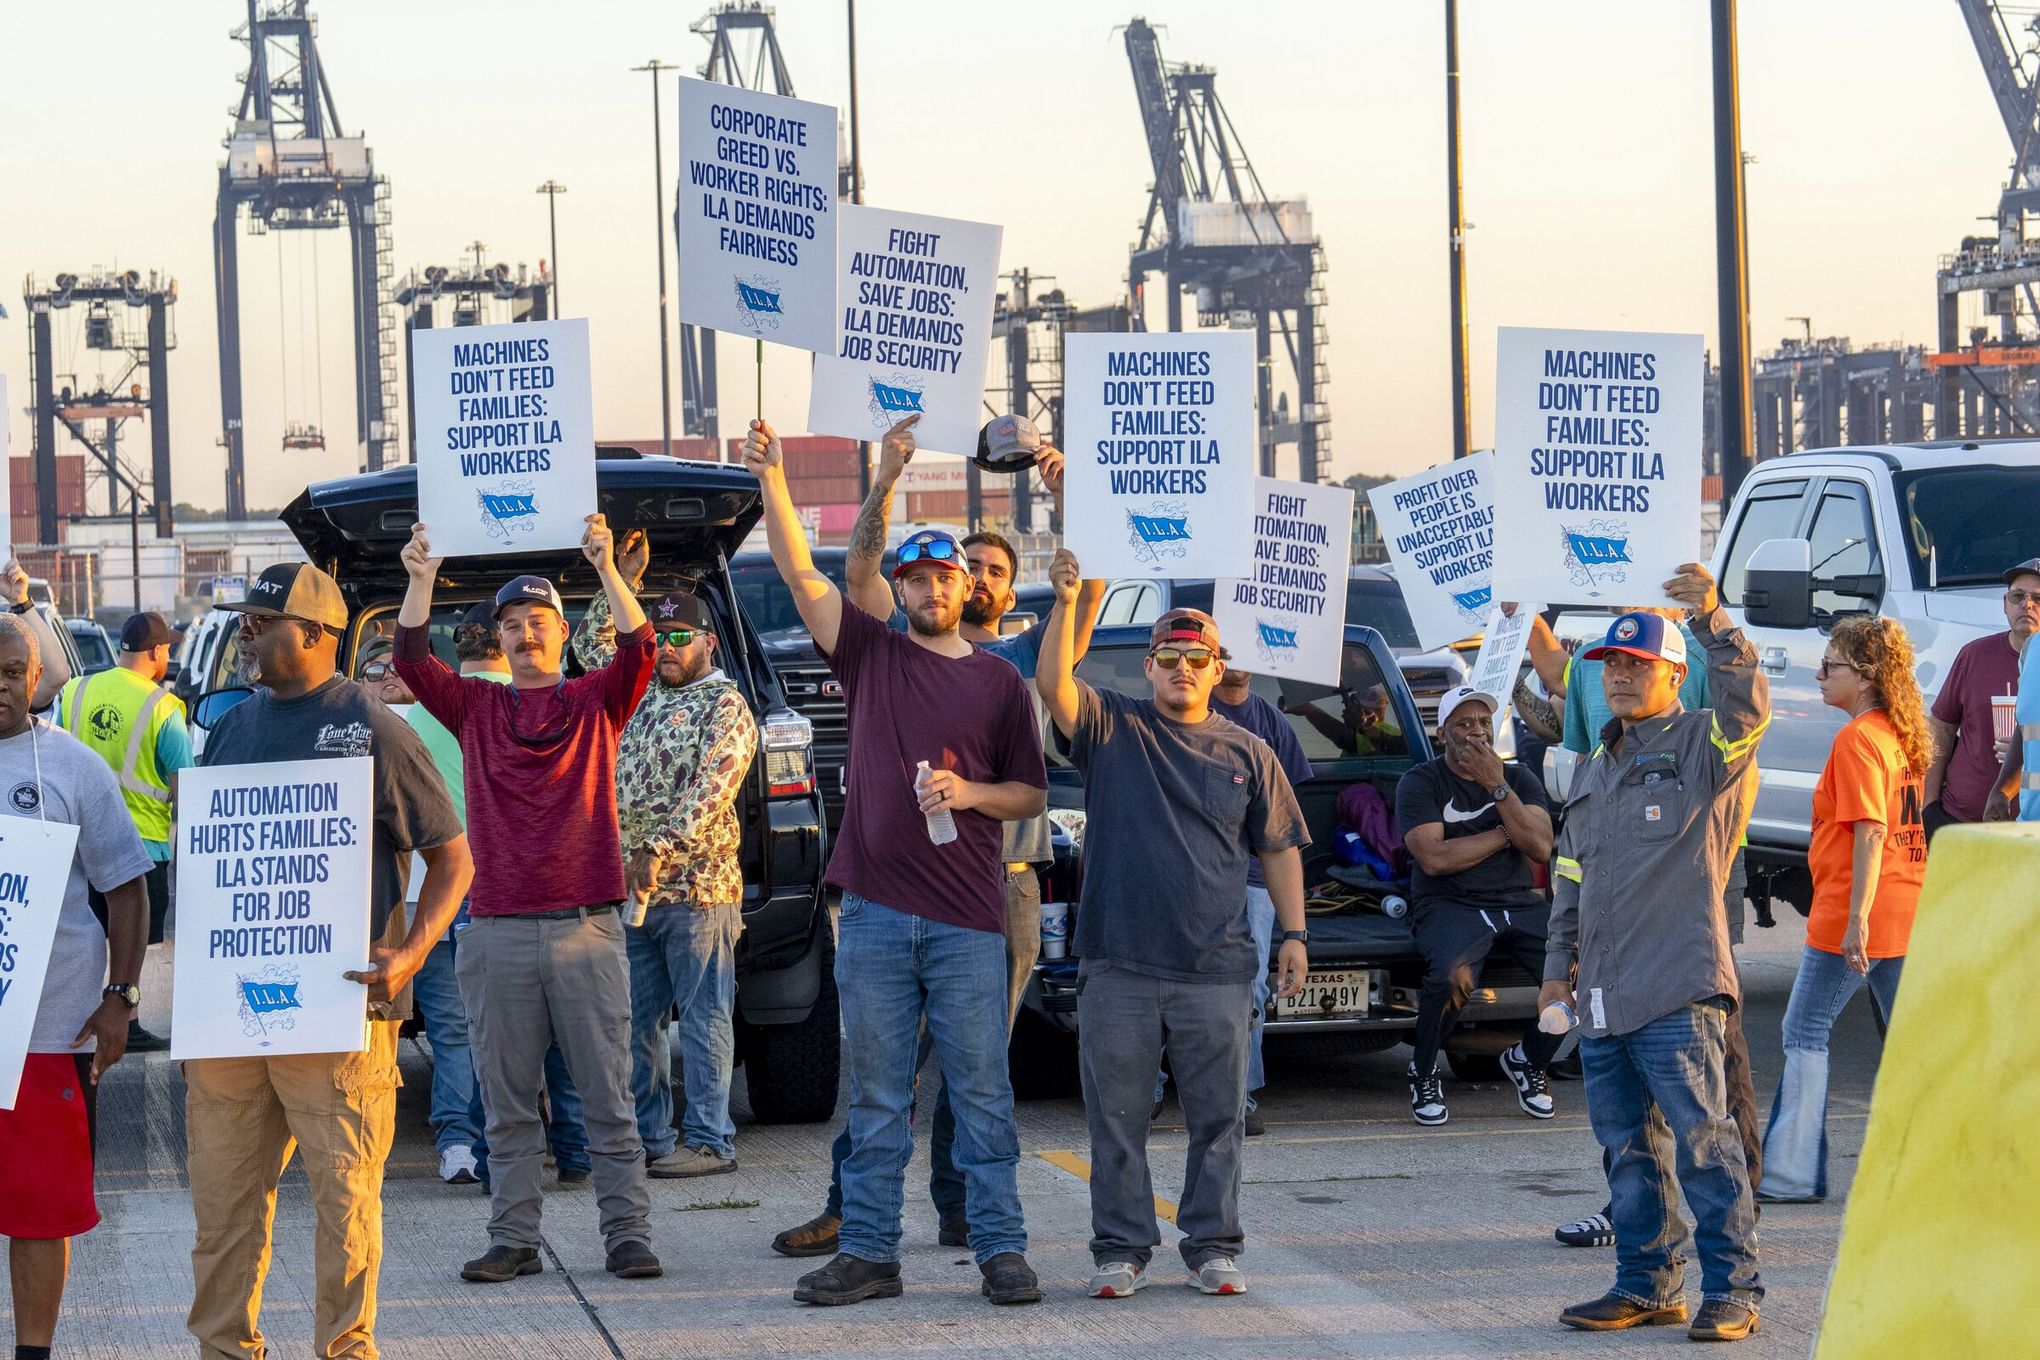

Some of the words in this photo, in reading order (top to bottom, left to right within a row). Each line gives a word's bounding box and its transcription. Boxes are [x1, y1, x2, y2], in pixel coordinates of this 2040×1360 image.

[711, 104, 806, 147] CORPORATE
[718, 136, 769, 169] GREED
[775, 148, 800, 176] VS.
[690, 160, 758, 198] WORKER
[765, 176, 827, 212] RIGHTS:
[704, 193, 729, 221] ILA
[735, 200, 814, 240] DEMANDS
[720, 227, 798, 266] FAIRNESS
[888, 228, 940, 258] FIGHT
[850, 252, 968, 294] AUTOMATION,
[746, 290, 777, 309] I.L.A.
[858, 281, 904, 310] SAVE
[907, 289, 955, 317] JOBS:
[844, 308, 871, 333] ILA
[876, 312, 964, 346] DEMANDS
[454, 338, 550, 367] MACHINES
[840, 336, 872, 360] JOB
[876, 340, 962, 374] SECURITY
[1108, 351, 1210, 376] MACHINES
[1544, 350, 1656, 380] MACHINES
[451, 369, 504, 394] DON'T
[510, 366, 554, 390] FEED
[1104, 381, 1161, 405] DON'T
[1166, 381, 1214, 405] FEED
[459, 394, 548, 422] FAMILIES:
[882, 390, 918, 408] I.L.A.
[1539, 383, 1602, 412] DON'T
[1607, 385, 1660, 414] FEED
[228, 419, 242, 428] 214
[447, 422, 529, 450] SUPPORT
[534, 420, 562, 444] ILA
[1112, 410, 1206, 435] FAMILIES:
[1547, 416, 1650, 446] FAMILIES:
[460, 449, 550, 476] WORKERS
[1097, 440, 1185, 464] SUPPORT
[1190, 440, 1220, 464] ILA
[1530, 448, 1627, 479] SUPPORT
[1632, 452, 1664, 480] ILA
[1110, 470, 1206, 494] WORKERS
[1394, 481, 1440, 512] PROFIT
[1441, 469, 1478, 495] OVER
[491, 498, 532, 513] I.L.A.
[1268, 494, 1306, 518] FIGHT
[1410, 496, 1461, 528] PEOPLE
[1460, 492, 1476, 510] IS
[1544, 482, 1649, 513] WORKERS
[1141, 522, 1184, 536] I.L.A.
[1254, 540, 1280, 562] AVE
[1283, 545, 1320, 568] JOBS:
[1414, 535, 1474, 570] SUPPORT
[1577, 540, 1623, 558] I.L.A.
[1262, 564, 1326, 592] DEMANDS
[1430, 550, 1492, 586] WORKERS
[1234, 584, 1257, 604] JOB
[1260, 589, 1326, 616] SECURITY
[1266, 628, 1294, 644] I.L.A.
[210, 782, 338, 818] AUTOMATION
[190, 823, 254, 854] HURTS
[260, 816, 356, 850] FAMILIES:
[1909, 848, 1922, 862] TO
[216, 858, 246, 888] ILA
[251, 853, 329, 886] STANDS
[232, 892, 270, 922] FOR
[275, 890, 310, 920] JOB
[210, 924, 332, 958] PROTECTION
[1305, 974, 1344, 984] TEXAS
[251, 988, 294, 1006] I.L.A.
